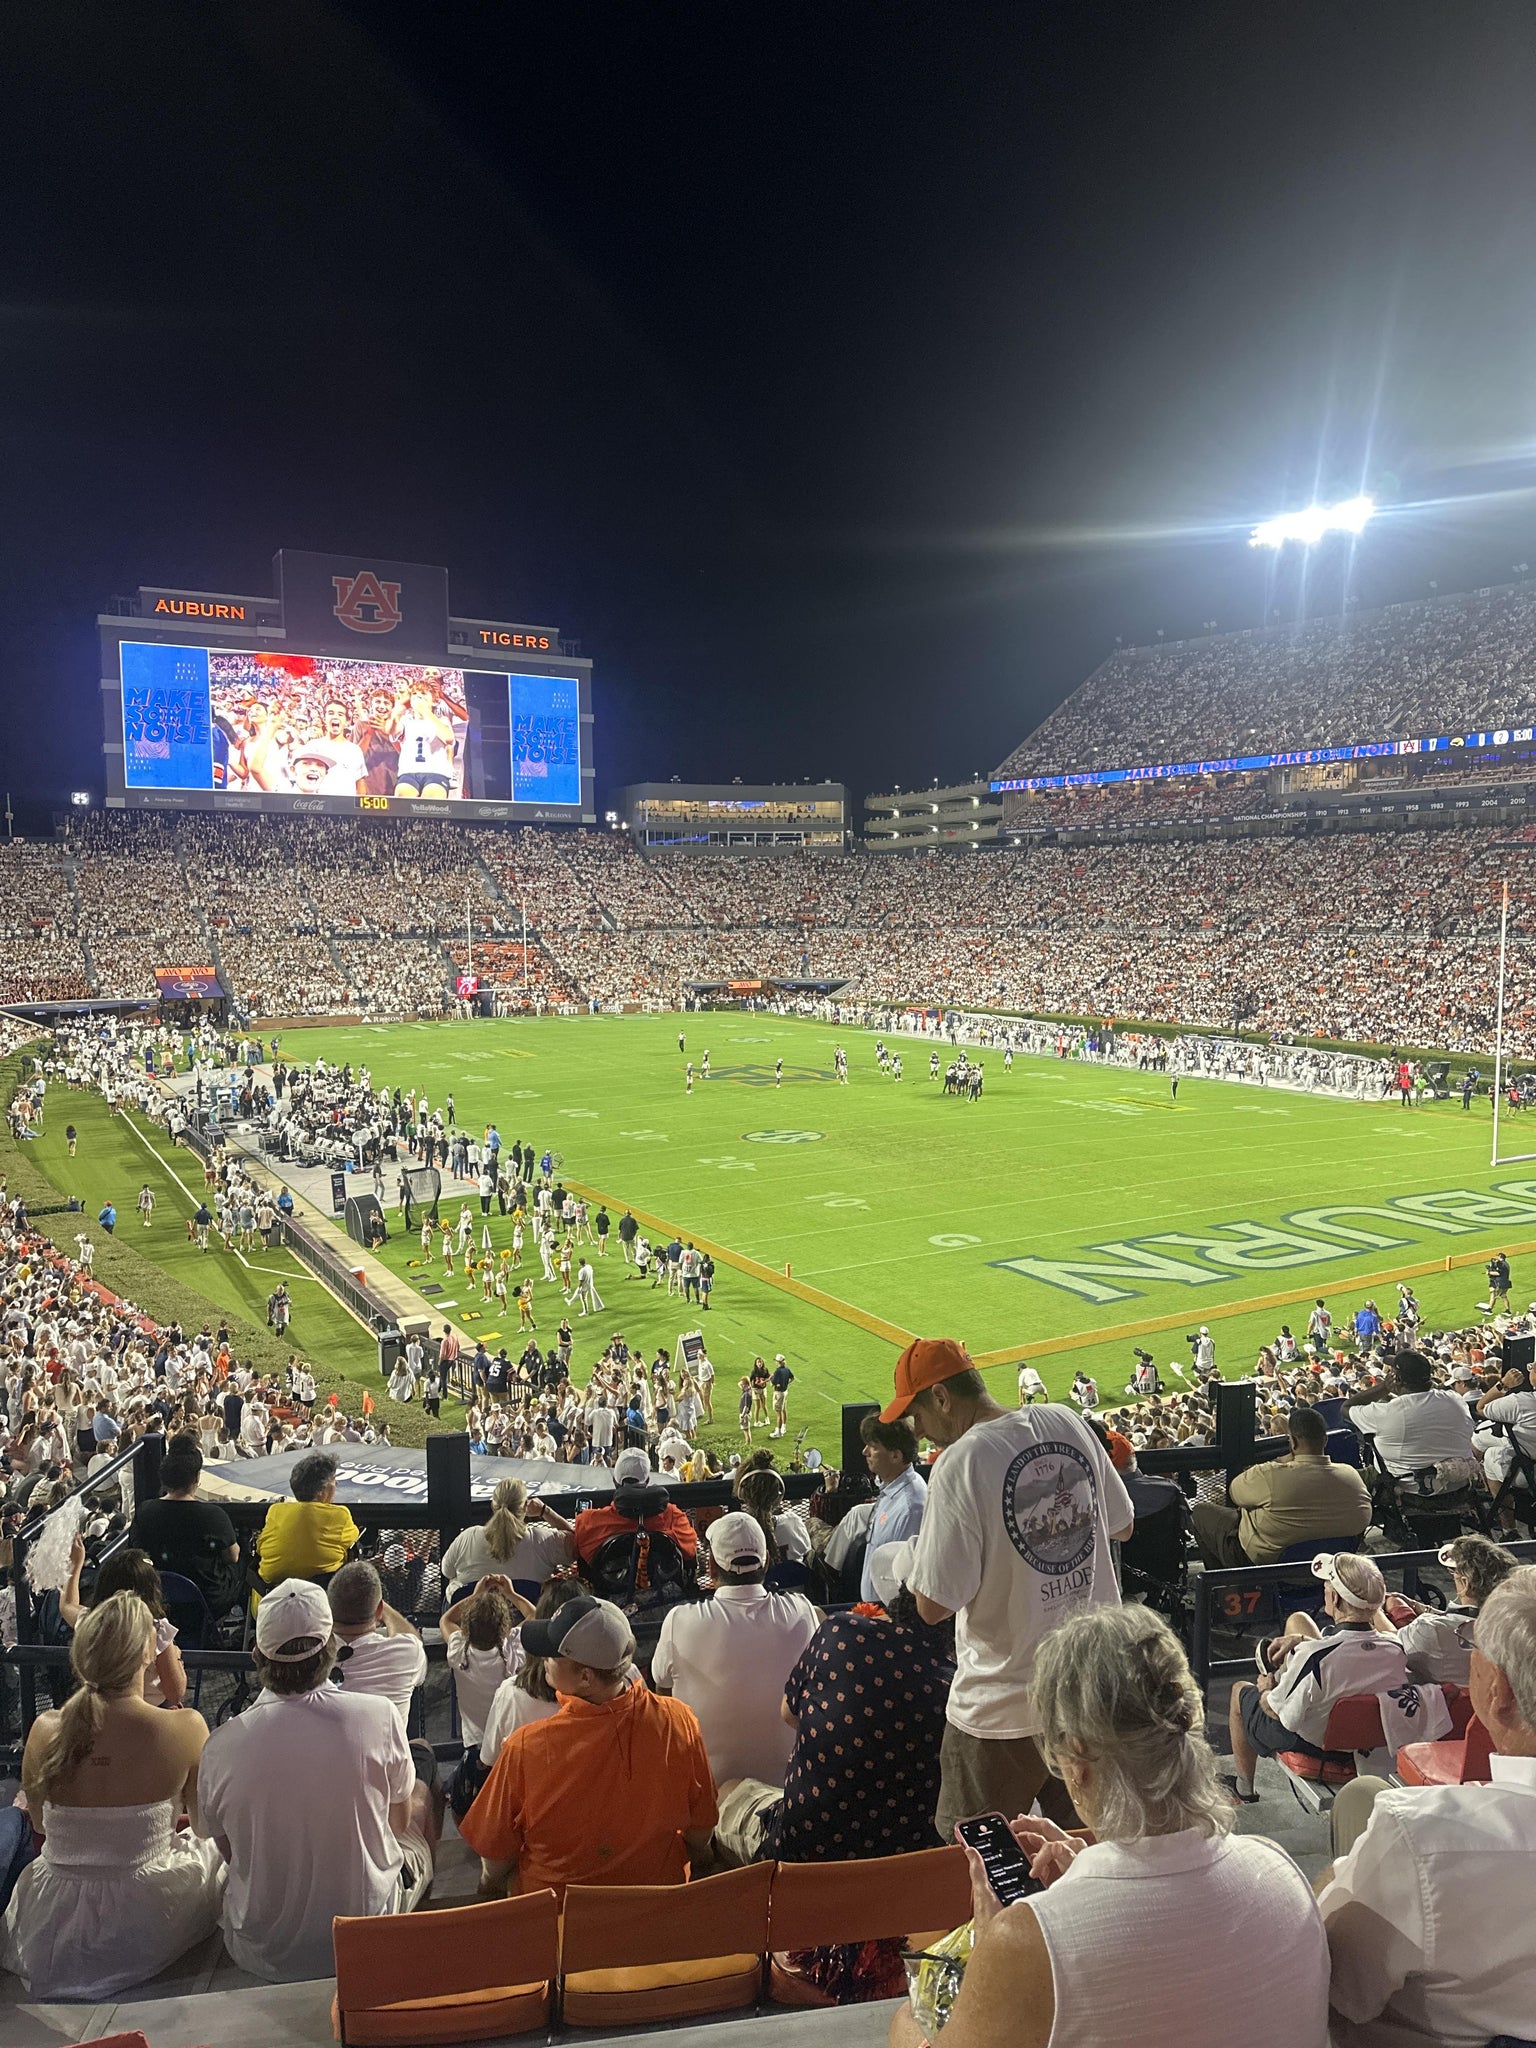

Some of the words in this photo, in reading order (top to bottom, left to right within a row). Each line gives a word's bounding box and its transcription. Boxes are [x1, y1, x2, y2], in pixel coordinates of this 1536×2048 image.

[154, 598, 245, 620] AUBURN
[480, 630, 549, 649] TIGERS
[126, 687, 206, 708] MAKE
[125, 705, 206, 725] SOME
[514, 714, 577, 734] MAKE
[126, 722, 209, 744] NOISE
[1513, 729, 1533, 742] 15:00
[415, 736, 426, 763] 1
[513, 746, 577, 765] NOISE
[1269, 751, 1307, 766] MAKE
[1311, 747, 1354, 762] SOME
[1124, 767, 1160, 780] MAKE
[1200, 759, 1243, 773] NOISE
[1000, 780, 1029, 791] MAKE
[1065, 773, 1104, 786] NOISE
[360, 797, 388, 810] 15:00
[1233, 814, 1261, 822] NATIONAL
[1261, 811, 1307, 820] CHAMPIONSHIPS
[1481, 799, 1498, 807] 2004
[606, 811, 617, 822] 25
[488, 1364, 501, 1377] 45
[340, 1461, 390, 1475] Pine
[1008, 1455, 1025, 1483] LAND
[1034, 1464, 1055, 1477] 1776
[1024, 1550, 1057, 1573] BECAUSE
[1058, 1562, 1071, 1573] OF
[1041, 1566, 1093, 1602] SHADE
[1224, 1591, 1262, 1616] 37
